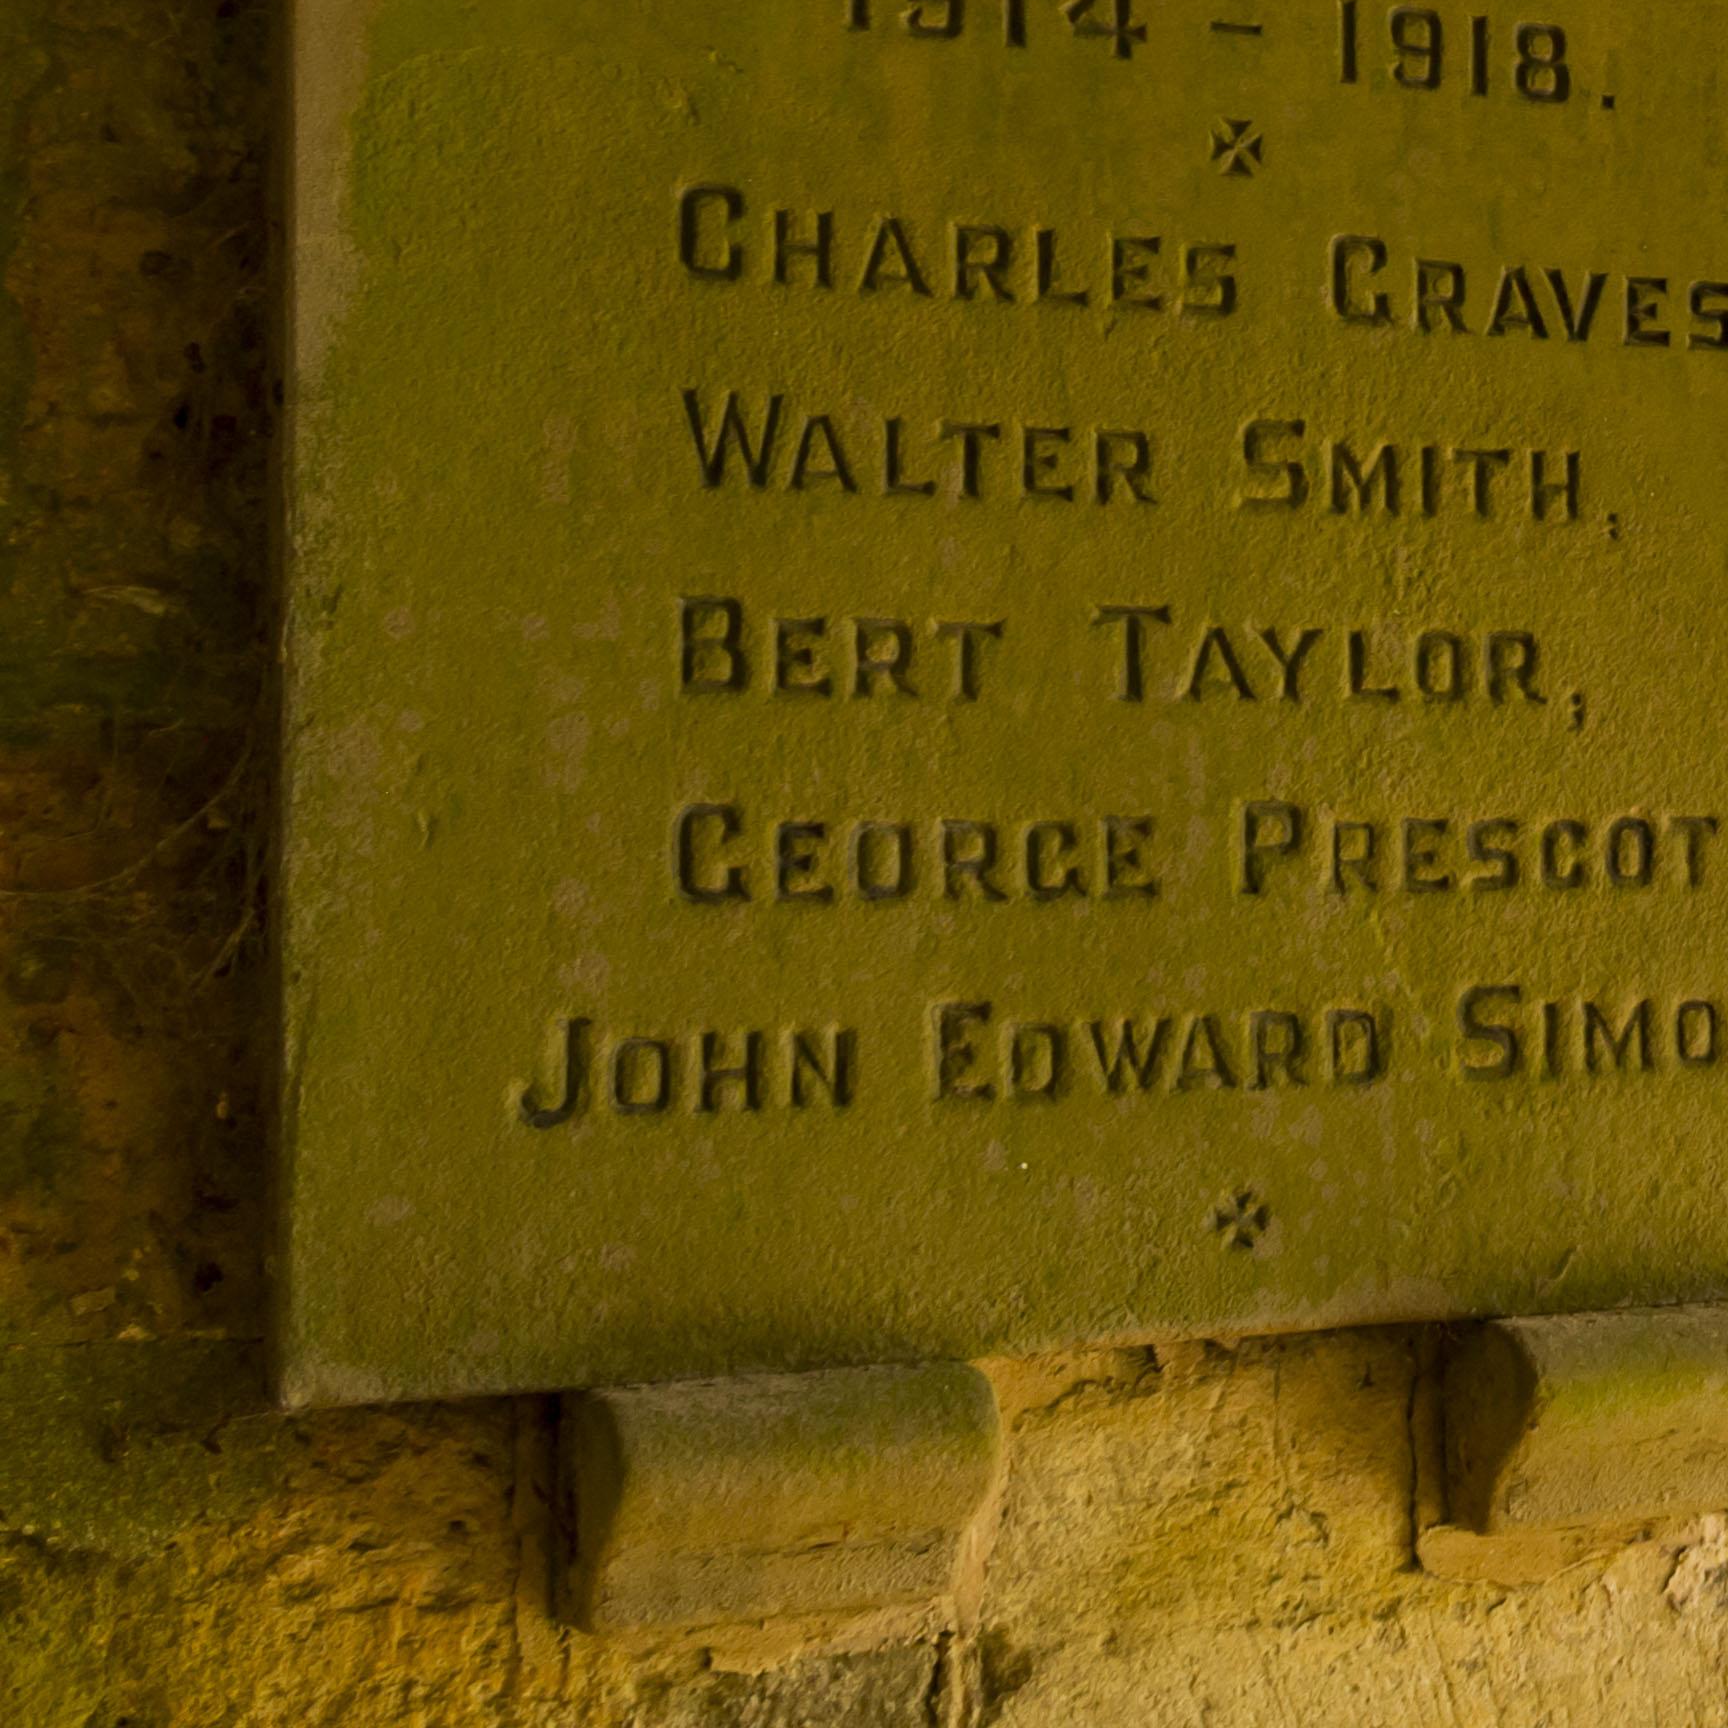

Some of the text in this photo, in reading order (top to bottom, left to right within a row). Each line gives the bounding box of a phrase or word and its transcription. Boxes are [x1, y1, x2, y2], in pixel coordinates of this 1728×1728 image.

[1337, 0, 1617, 110] 1918.
[676, 182, 1240, 317] CHARLES
[682, 385, 1159, 505] WALTER
[680, 595, 1007, 702] BERT
[672, 802, 1162, 904] GEORGE
[518, 1016, 858, 1129] JOHN
[930, 1000, 1389, 1102] EDWARD
